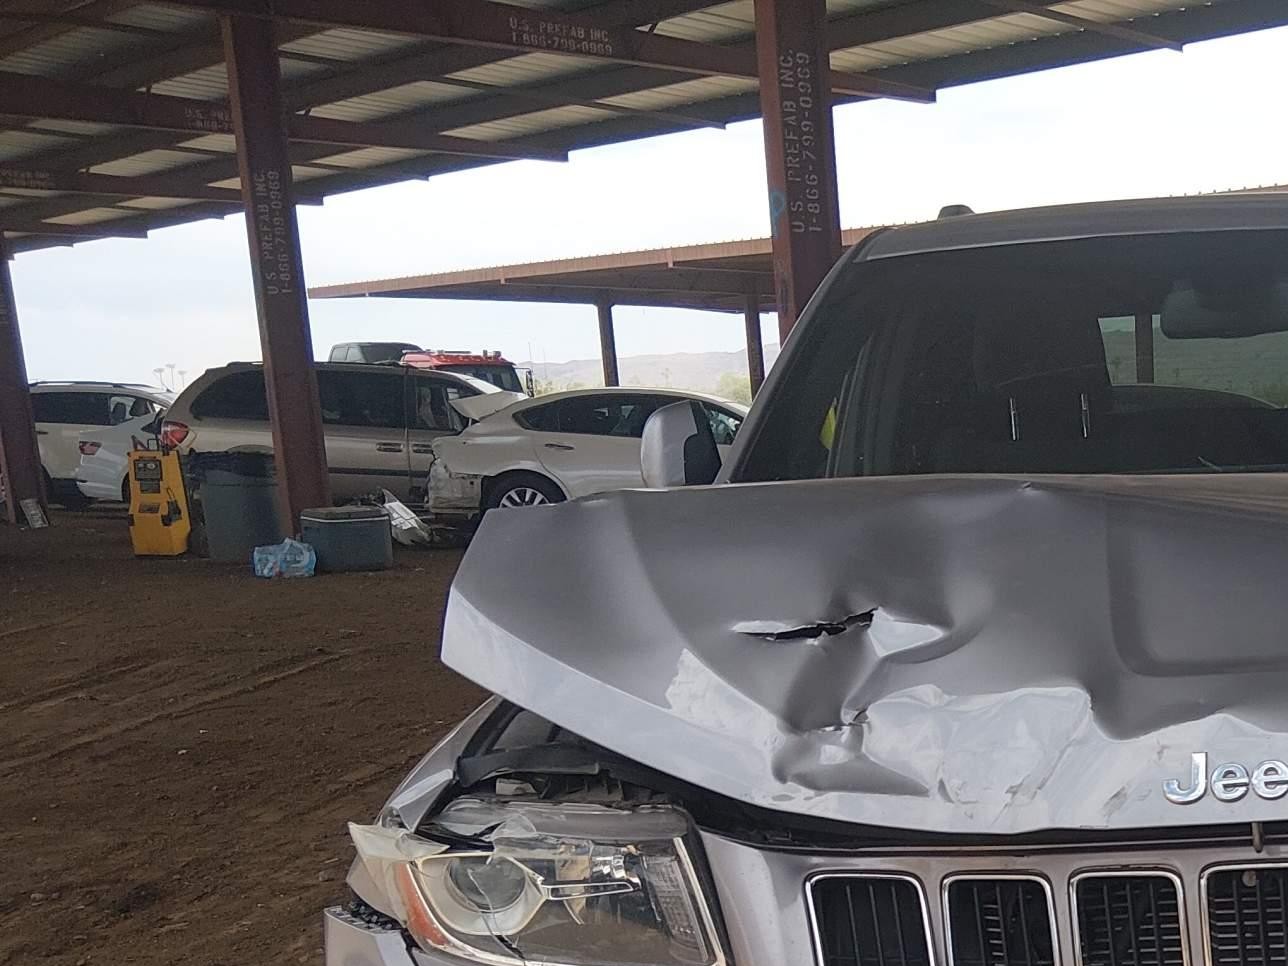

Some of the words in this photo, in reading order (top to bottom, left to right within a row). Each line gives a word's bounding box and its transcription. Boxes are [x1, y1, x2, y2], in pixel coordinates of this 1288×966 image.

[539, 23, 585, 40] PREFAB
[780, 50, 795, 88] INC.
[783, 101, 801, 182] PREFAB
[796, 53, 823, 232] 1-866-799-0969
[257, 203, 275, 260] PREFAB
